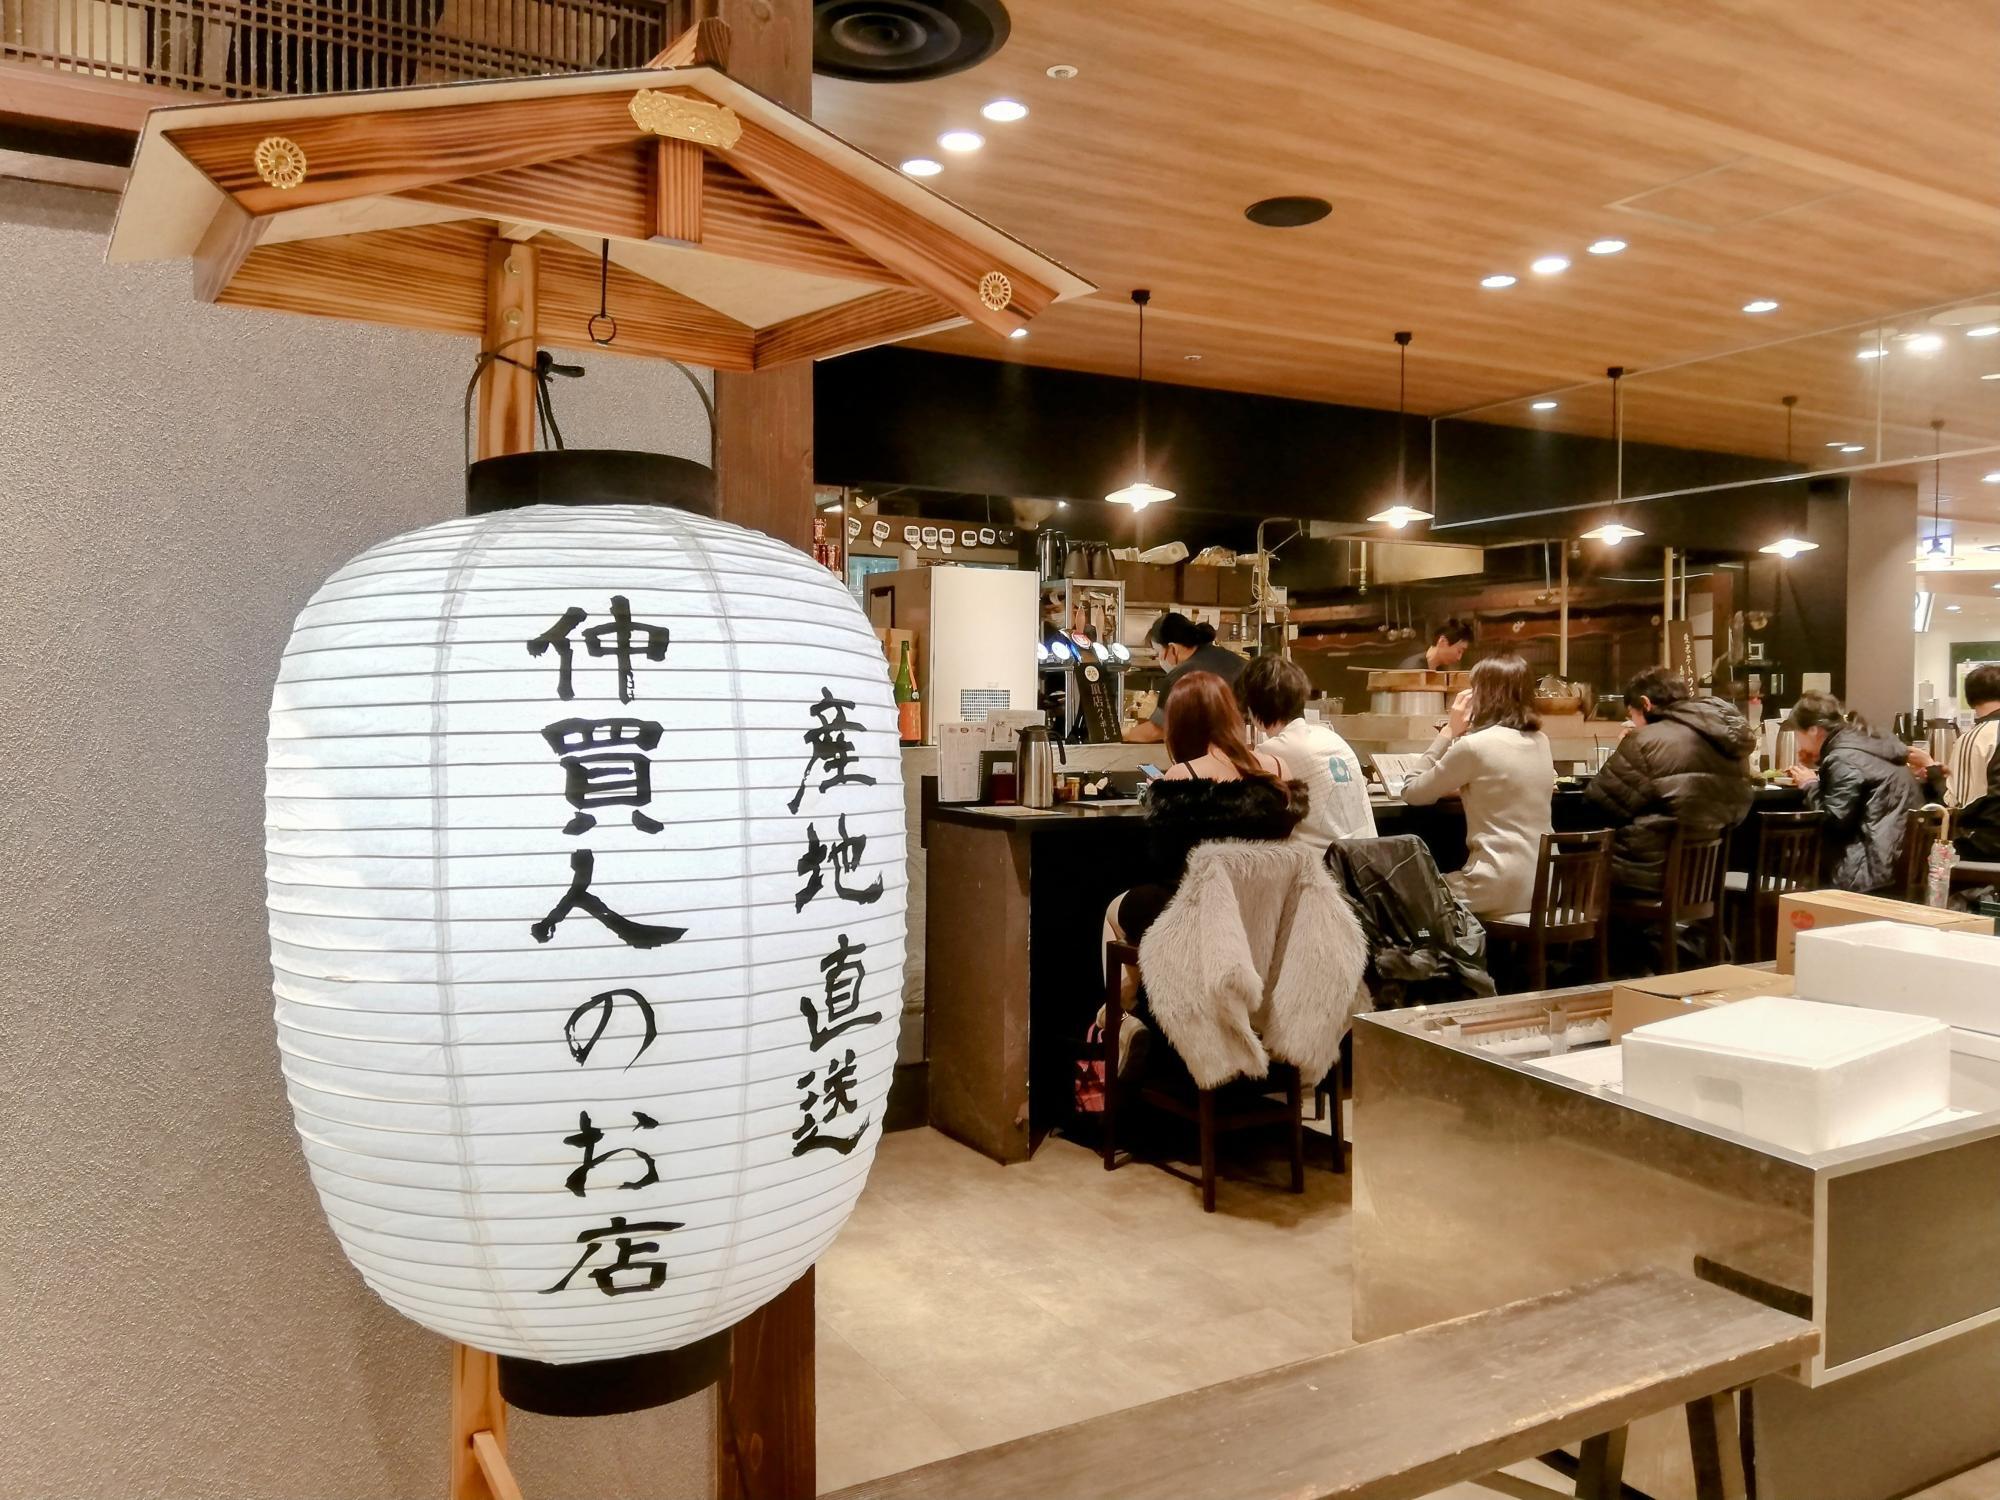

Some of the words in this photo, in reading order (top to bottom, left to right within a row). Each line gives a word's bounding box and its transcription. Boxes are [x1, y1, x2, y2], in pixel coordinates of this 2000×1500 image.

[528, 595, 689, 1297] 仲買人のお店
[787, 686, 884, 1157] 産地直送
